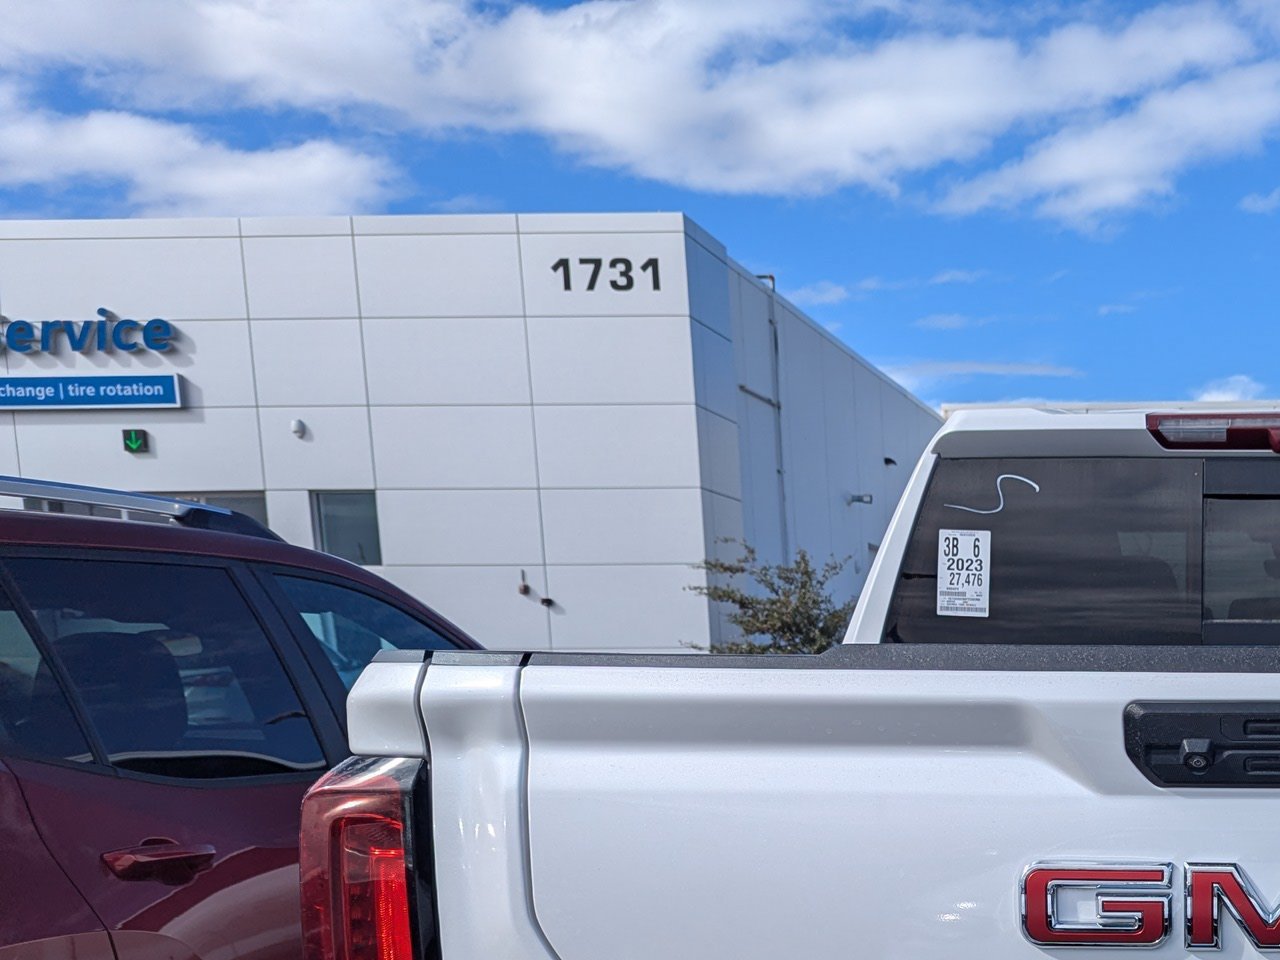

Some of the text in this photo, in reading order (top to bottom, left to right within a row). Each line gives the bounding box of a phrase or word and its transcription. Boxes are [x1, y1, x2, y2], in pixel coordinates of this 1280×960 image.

[550, 258, 661, 291] 1731
[0, 307, 172, 352] ervice
[68, 384, 96, 397] tire
[100, 382, 163, 396] rotation
[943, 537, 980, 558] 3B 6
[946, 558, 983, 572] 2023
[949, 572, 983, 588] 27,476
